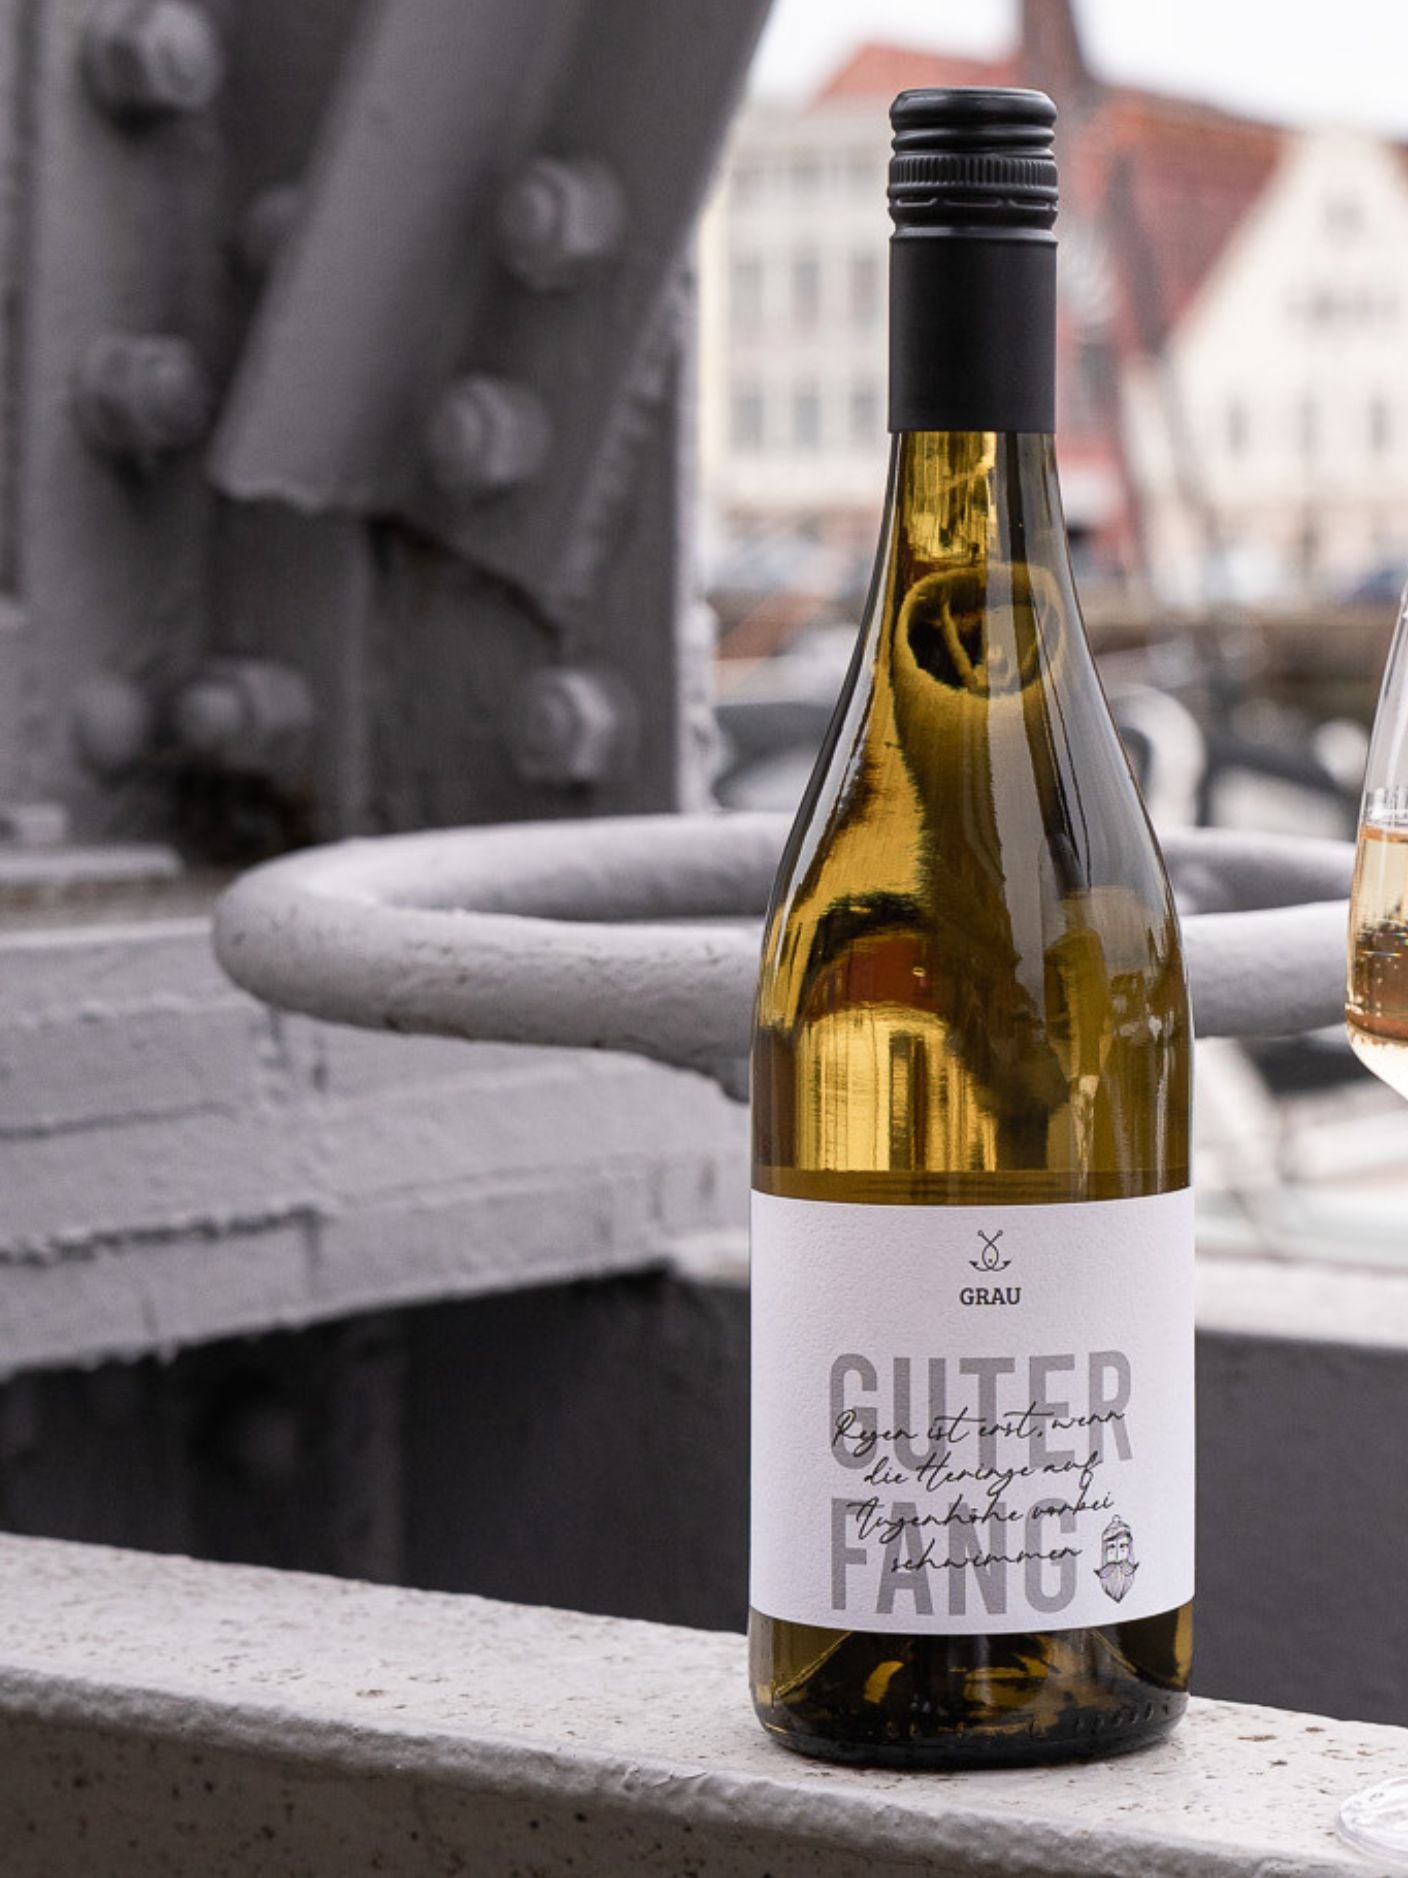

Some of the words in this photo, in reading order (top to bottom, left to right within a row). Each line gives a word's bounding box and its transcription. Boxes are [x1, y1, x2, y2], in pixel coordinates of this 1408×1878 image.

[959, 1287, 1022, 1306] GRAU
[830, 1351, 1133, 1470] GUTER
[832, 1409, 917, 1457] Regen
[927, 1406, 986, 1443] ist
[1051, 1409, 1125, 1430] wenn
[864, 1456, 909, 1486] die
[917, 1452, 1034, 1498] Heringe
[1042, 1451, 1103, 1501] auf
[1031, 1489, 1115, 1523] vorbei
[830, 1497, 1077, 1616] FANG
[891, 1538, 1084, 1573] schwimmen
